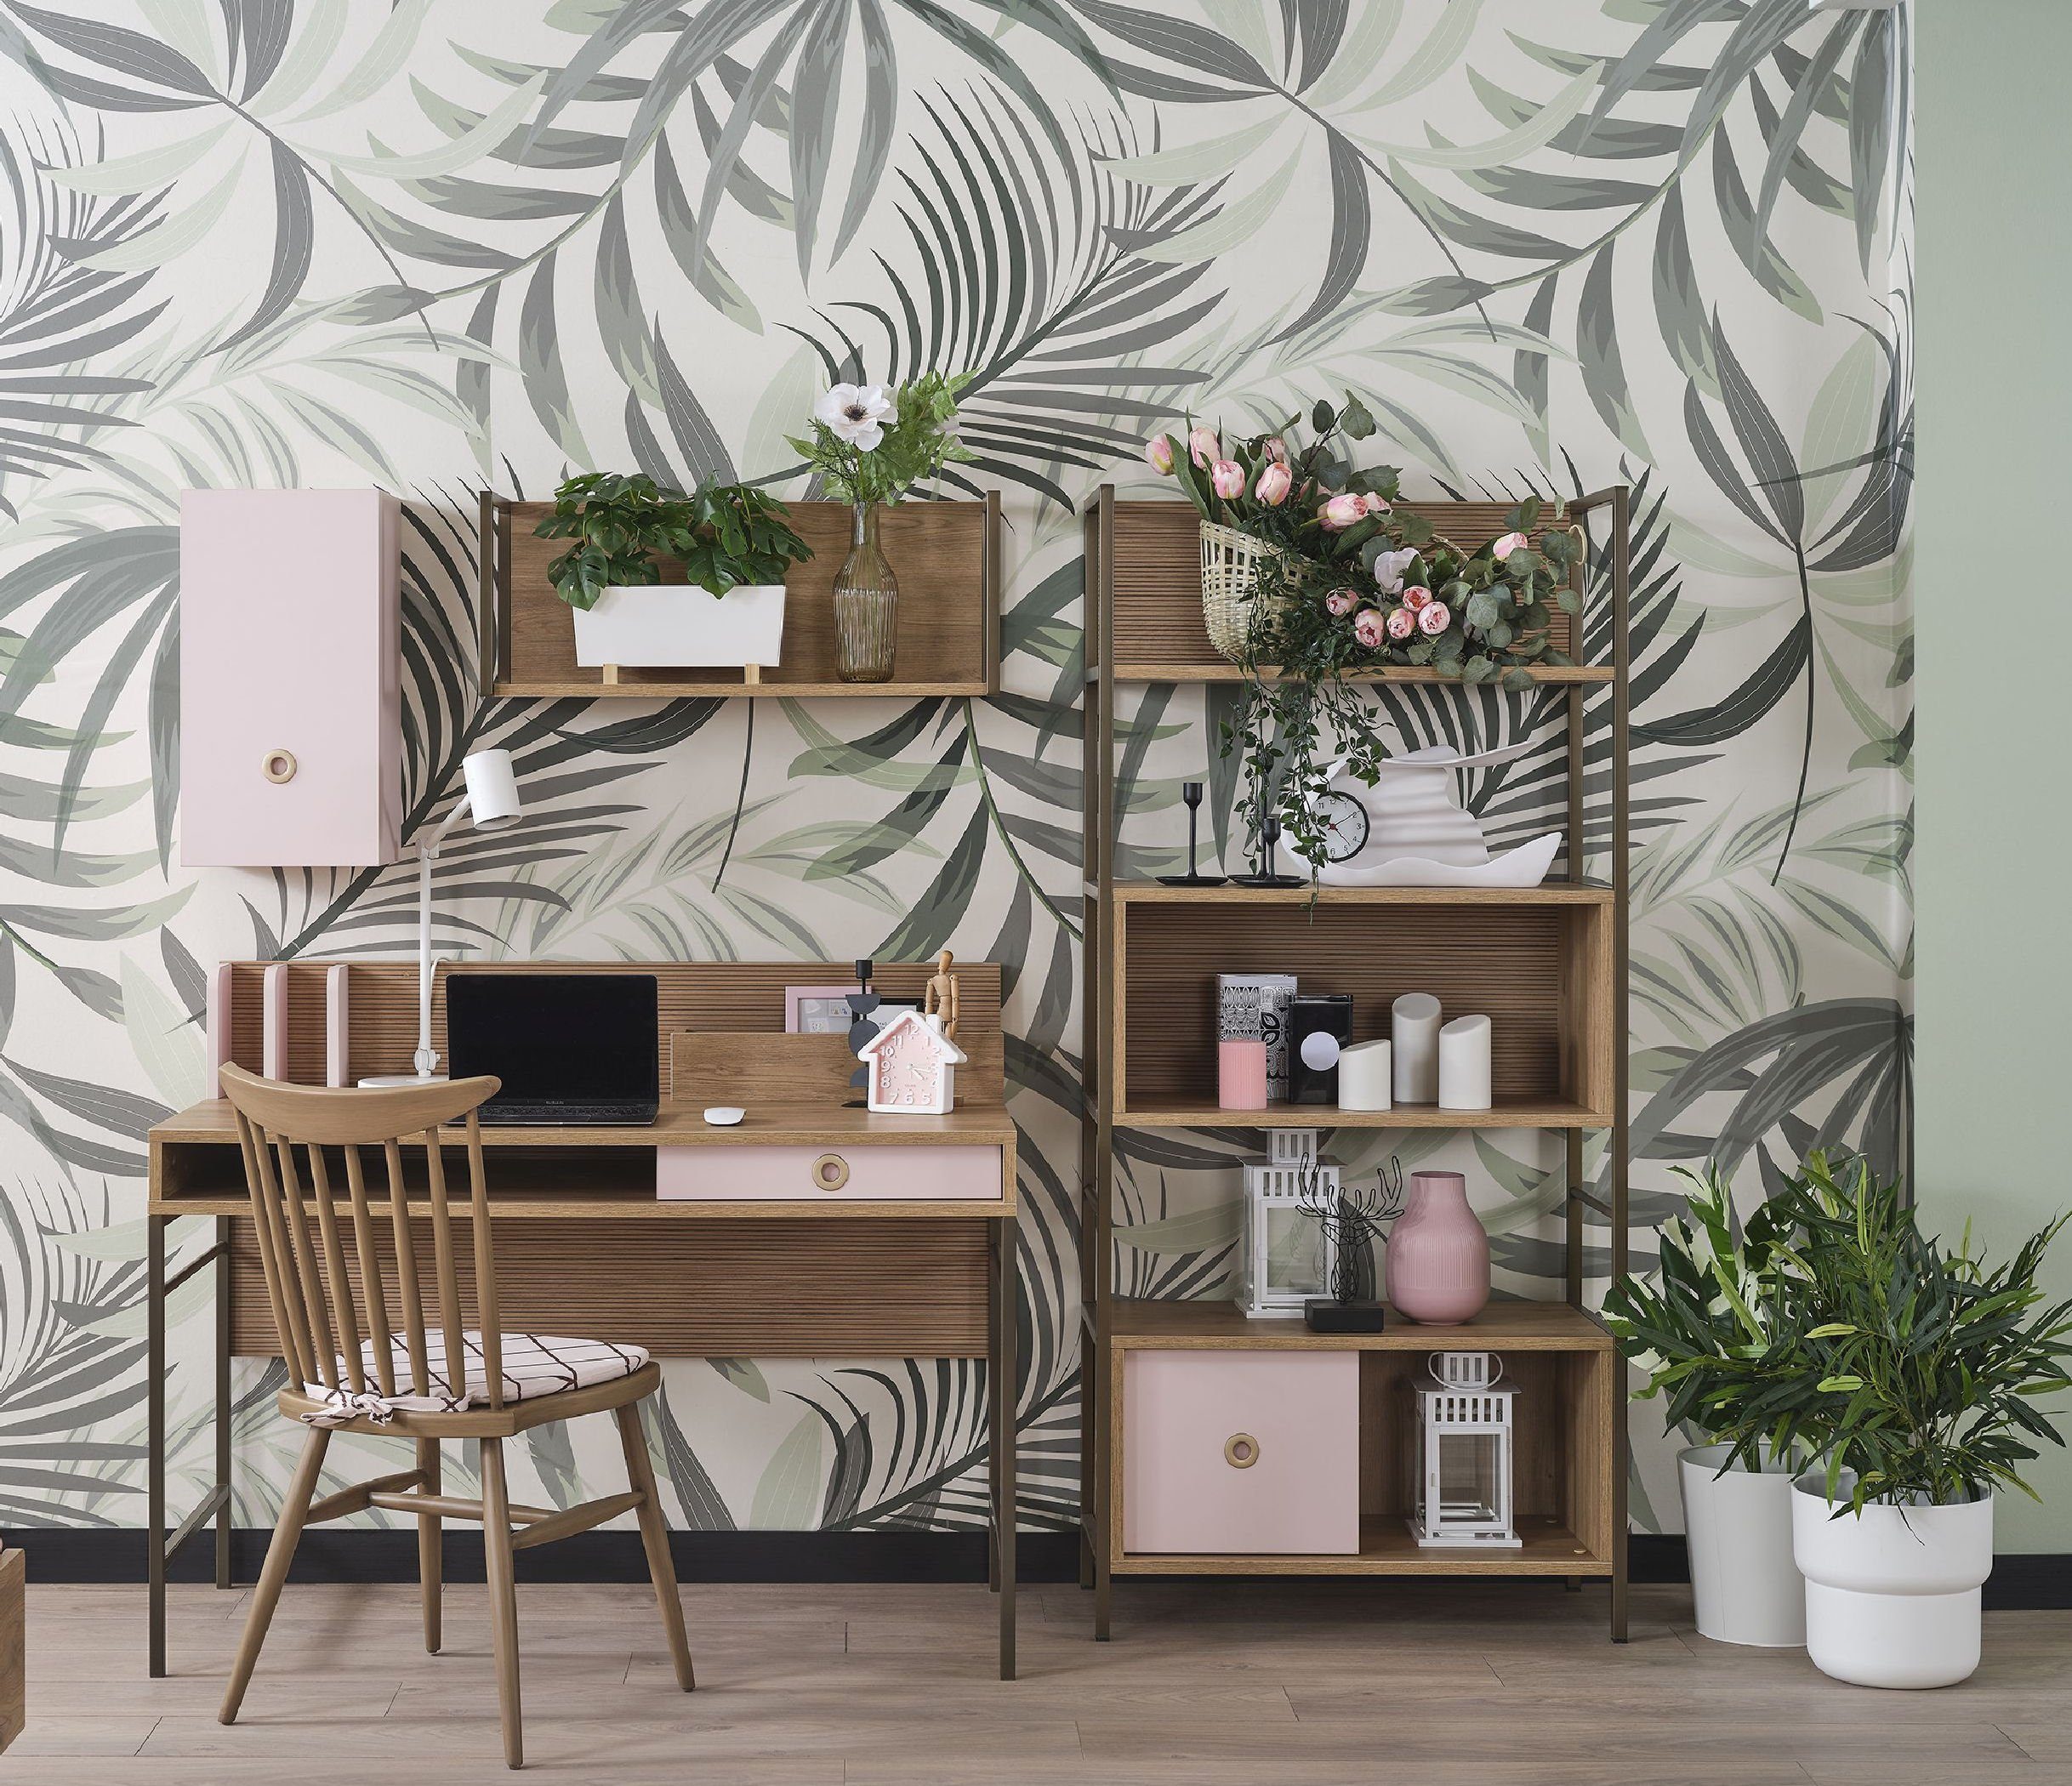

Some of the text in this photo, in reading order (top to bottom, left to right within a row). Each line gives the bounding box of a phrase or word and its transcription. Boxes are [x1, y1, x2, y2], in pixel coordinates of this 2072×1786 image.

[905, 1024, 919, 1035] 12
[892, 1035, 902, 1049] 11
[925, 1036, 931, 1046] 1
[880, 1045, 895, 1057] 10
[932, 1047, 942, 1056] 2
[880, 1060, 891, 1072] 9
[879, 1075, 891, 1089] 8
[889, 1090, 898, 1104] 7
[904, 1090, 914, 1105] 6
[922, 1092, 931, 1105] 5
